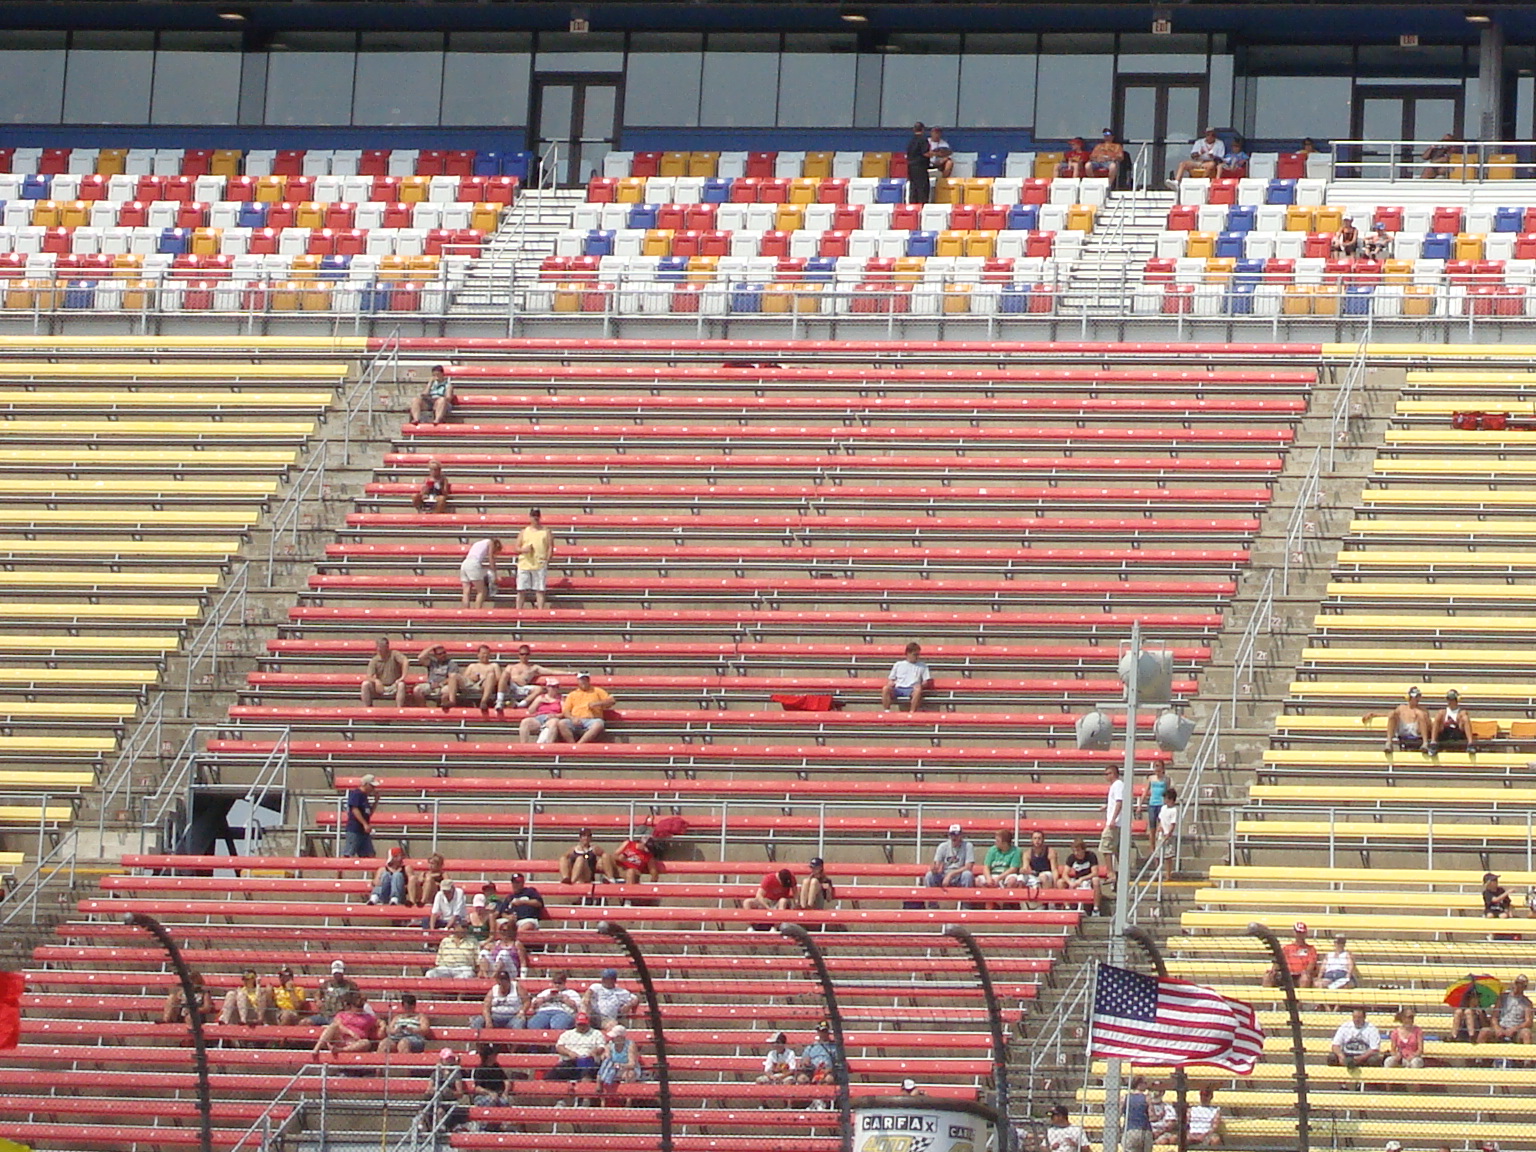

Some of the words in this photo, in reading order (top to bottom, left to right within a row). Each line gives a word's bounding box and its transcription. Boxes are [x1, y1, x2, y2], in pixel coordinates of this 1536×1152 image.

[1150, 907, 1160, 918] 14
[1044, 1079, 1052, 1090] 7
[863, 1116, 935, 1132] CARFAX
